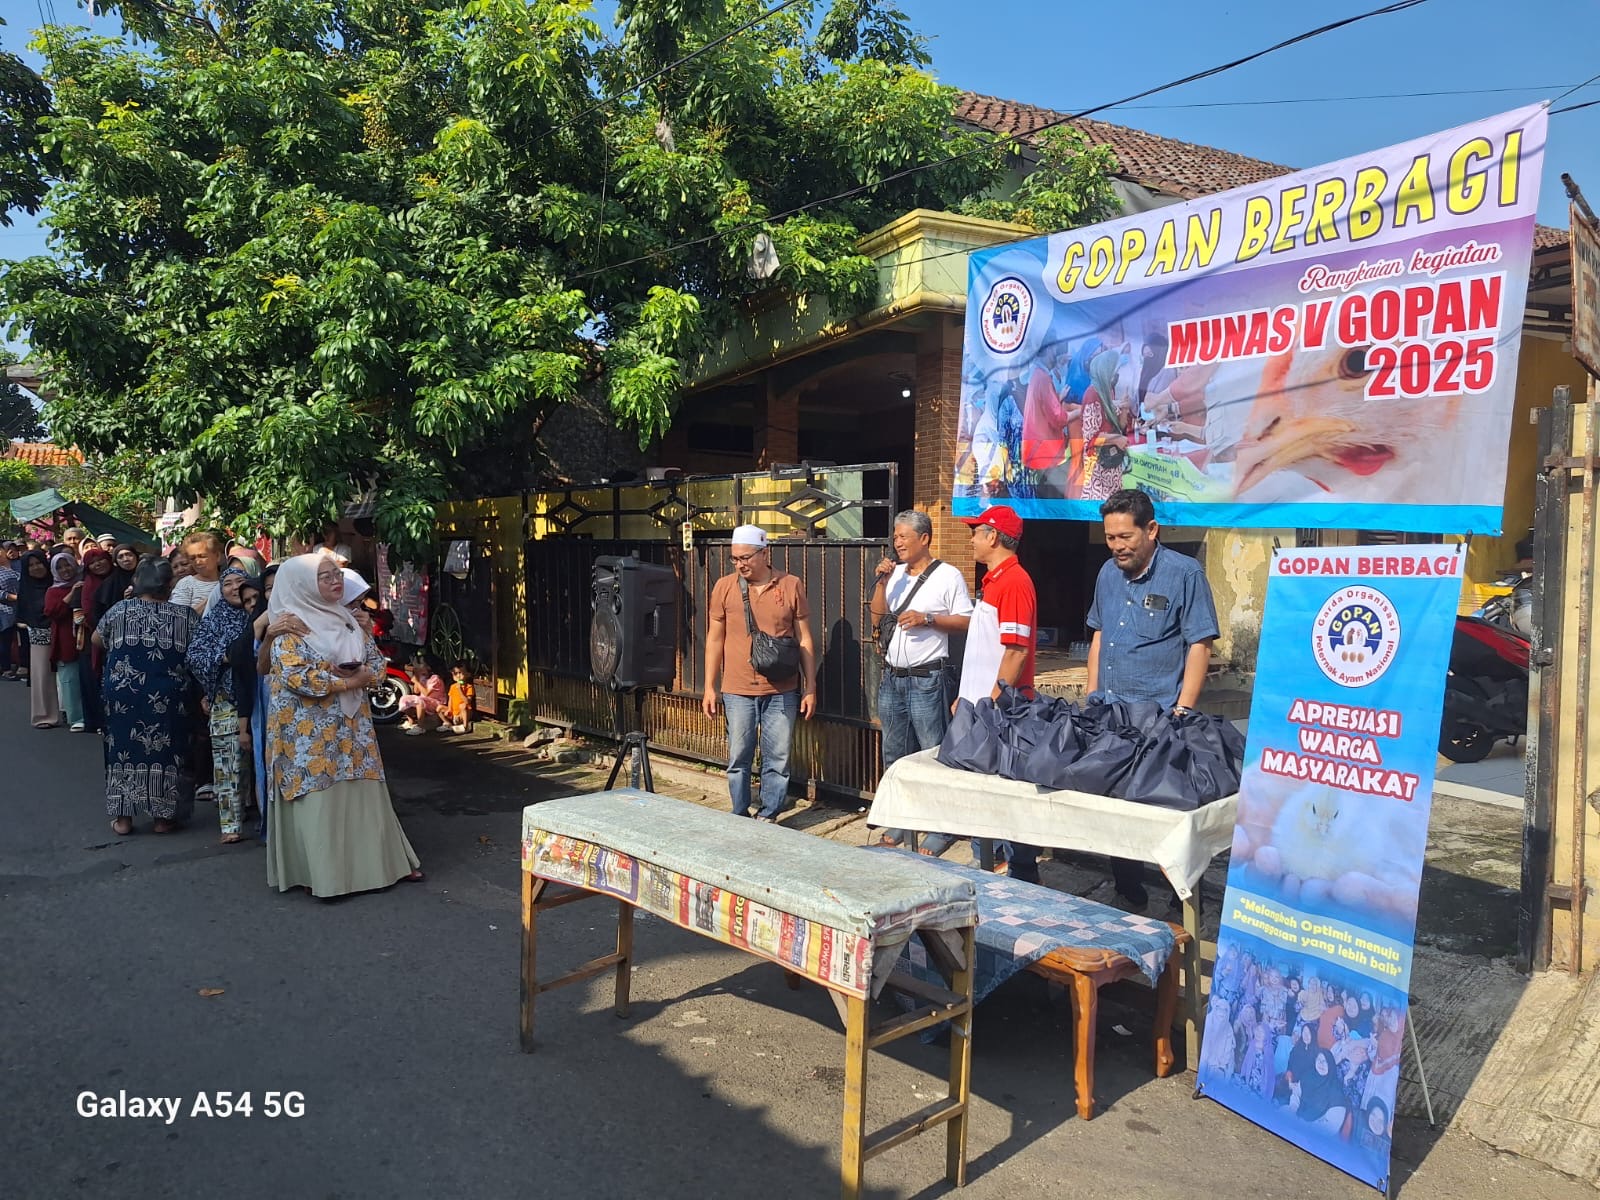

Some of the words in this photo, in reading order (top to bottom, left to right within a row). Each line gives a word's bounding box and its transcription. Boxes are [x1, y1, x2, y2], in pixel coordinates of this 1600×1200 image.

[1056, 208, 1221, 294] GOPAN
[1235, 128, 1524, 263] BERBAGI
[1300, 260, 1401, 291] Rangkaian
[1410, 243, 1499, 274] kegiatan
[995, 294, 1019, 315] GOPAN
[1168, 309, 1295, 365] MUNAS
[1303, 300, 1333, 348] V
[1338, 276, 1502, 344] GOPAN
[1367, 337, 1495, 396] 2025
[1278, 557, 1350, 575] GOPAN
[1358, 556, 1458, 575] BERBAGI
[1318, 596, 1343, 627] Garda
[1347, 590, 1397, 631] Organisasi
[1332, 607, 1381, 635] GOPAN
[1316, 635, 1338, 677] Peternak
[1338, 673, 1364, 683] Ayam
[1365, 640, 1395, 679] Nasional
[1290, 701, 1398, 735] APRESIASI
[1300, 729, 1379, 763] WARGA
[1262, 750, 1417, 799] MASYARAKAT
[1233, 909, 1298, 943] Perunggasan
[1301, 936, 1335, 954] yang
[1338, 943, 1366, 965] lebih
[1301, 920, 1352, 944] Optimis
[1355, 937, 1399, 961] menuju
[821, 943, 832, 977] PROMO
